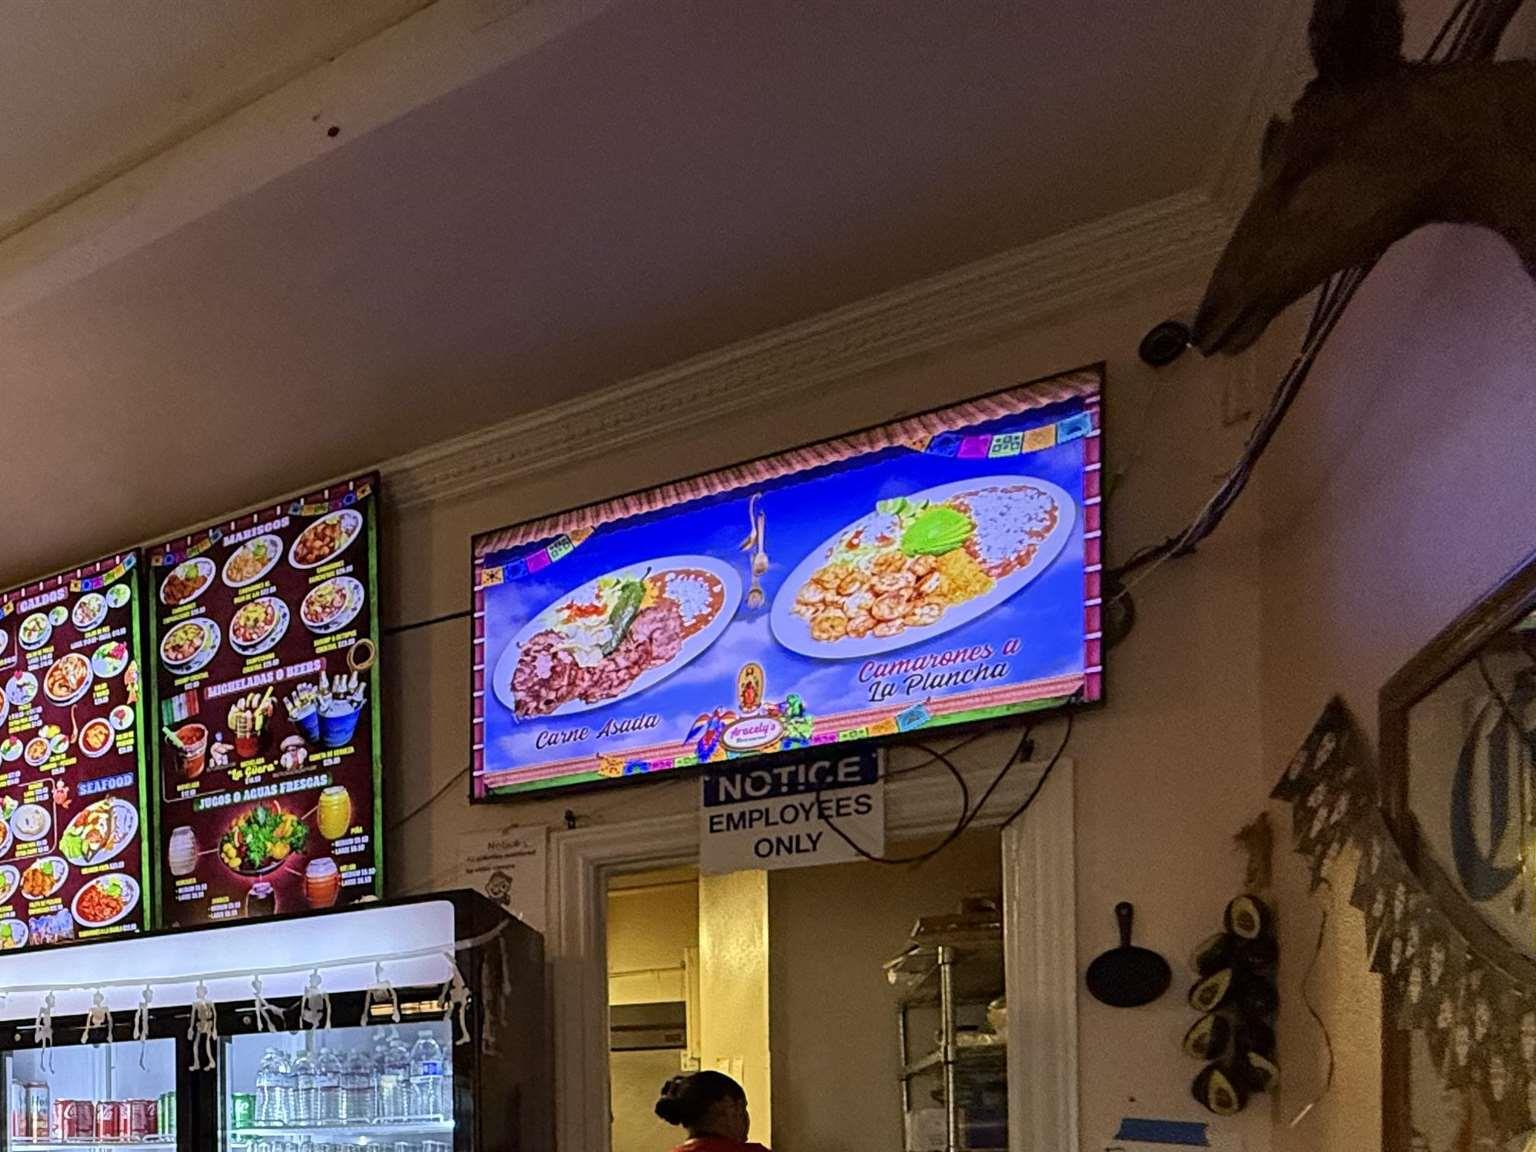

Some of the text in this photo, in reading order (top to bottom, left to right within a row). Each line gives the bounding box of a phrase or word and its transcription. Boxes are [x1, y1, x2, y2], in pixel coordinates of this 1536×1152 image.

[223, 516, 290, 547] MARISCOS
[20, 588, 66, 612] CALDOS
[207, 669, 274, 698] MICHELADAS
[275, 668, 285, 681] O
[286, 659, 321, 679] BEERS
[859, 638, 1020, 683] Camarones a
[868, 662, 1009, 702] La Plancha
[536, 713, 659, 749] Carne Asada
[79, 773, 134, 795] SEAFOOD
[200, 793, 232, 810] JUGOS
[244, 784, 277, 801] AGUAS
[280, 774, 328, 793] FRESCAS
[718, 756, 862, 802] NOTICE
[709, 794, 873, 834] EMPLOYEES
[753, 832, 824, 859] ONLY
